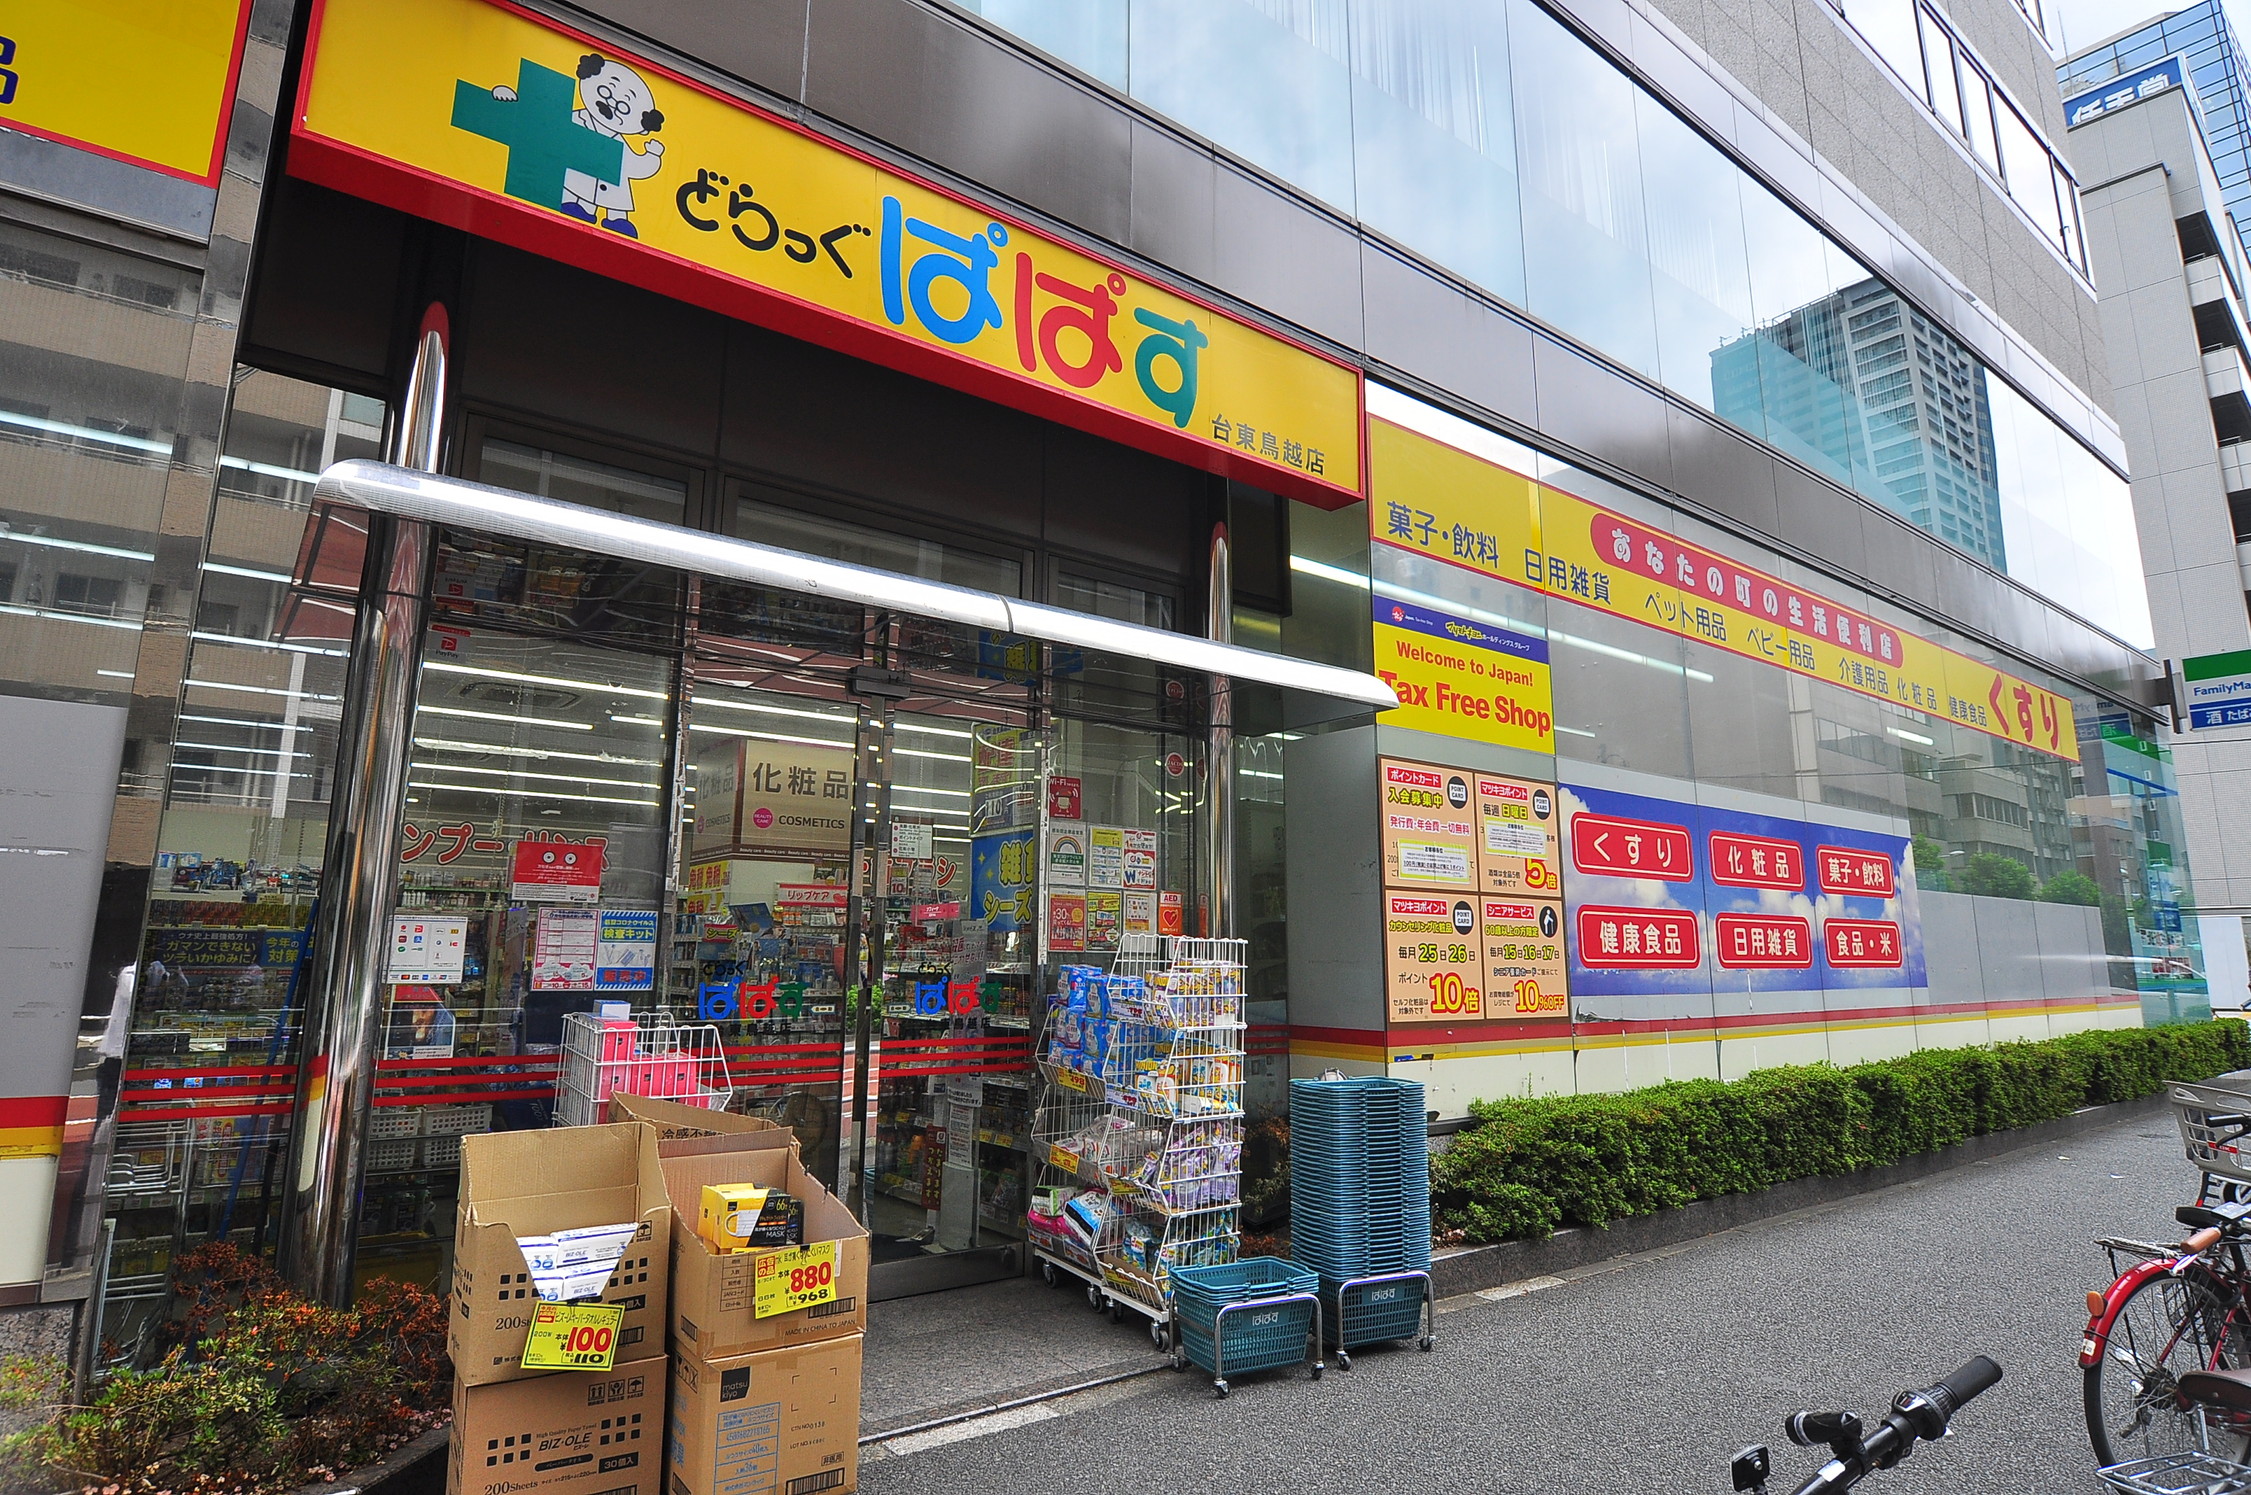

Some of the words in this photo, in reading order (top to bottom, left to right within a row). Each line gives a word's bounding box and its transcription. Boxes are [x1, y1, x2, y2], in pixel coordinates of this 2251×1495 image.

[675, 167, 872, 280] どらっぐ
[879, 195, 1209, 428] ぱぱす
[1210, 411, 1327, 477] 台東鳥越店
[1611, 527, 1893, 661] あなたの町の生活便利店
[1386, 500, 1499, 569] 菓子・飲料
[1524, 548, 1612, 606] 日用雑貨
[1645, 592, 1727, 642] ペット用品
[1747, 627, 1815, 671] ベビー用品
[1840, 657, 1889, 697] 介護用品
[1897, 676, 1937, 712] 化粧品
[1949, 695, 1988, 728] 健康食品
[1989, 674, 2059, 751] くすり
[1396, 640, 1465, 671] Welcome
[1470, 659, 1484, 675] to
[1488, 663, 1533, 687] Japan!
[1378, 670, 1429, 708] Tax
[1435, 681, 1490, 719] Free
[1494, 695, 1551, 738] Shop
[2206, 710, 2223, 725] 酒
[752, 762, 849, 800] 化粧品
[1391, 770, 1439, 785] ポイントカード
[1388, 787, 1443, 809] 入会募集中
[1481, 784, 1528, 799] マツキヨポイント
[1483, 803, 1500, 817] 毎週
[1502, 803, 1528, 820] 日曜日
[778, 815, 845, 830] COSMETICS
[1593, 832, 1672, 867] くすり
[1727, 845, 1790, 879] 化粧品
[1827, 857, 1885, 888] 菓子・飲料
[787, 890, 829, 901] リップケア
[1163, 894, 1178, 902] AED
[1394, 901, 1446, 913] マツキヨポイント
[1488, 905, 1533, 918] シニアサービス
[604, 928, 652, 939] 検査キット
[1389, 920, 1453, 934] カウンセリング化粧品
[1485, 924, 1539, 937] 60歳以上の方限定
[266, 937, 299, 948] 今年の
[1600, 920, 1681, 956] 健康食品
[1733, 927, 1798, 957] 日用雑貨
[1836, 930, 1893, 957] 食品・米
[167, 941, 256, 952] ガマンできない
[268, 950, 298, 963] 対策
[603, 970, 647, 983] 販売中
[1398, 972, 1427, 984] ポイント
[699, 976, 809, 1020] ぱぱす
[915, 976, 1002, 1015] ぱぱす
[1393, 998, 1428, 1006] セルフ化粧品は
[1398, 1007, 1424, 1015] 対象外です
[766, 1231, 785, 1239] MASK
[778, 1270, 790, 1278] 本体
[1371, 1287, 1396, 1302] ぱぱす
[1252, 1312, 1279, 1326] ぱぱす
[785, 1328, 802, 1337] MADE
[810, 1324, 828, 1332] CHINA
[838, 1319, 856, 1328] JAPAN
[723, 1381, 748, 1391] matsu
[722, 1390, 738, 1400] kiyo
[548, 1429, 566, 1438] Quality
[604, 1456, 634, 1469] 30個入
